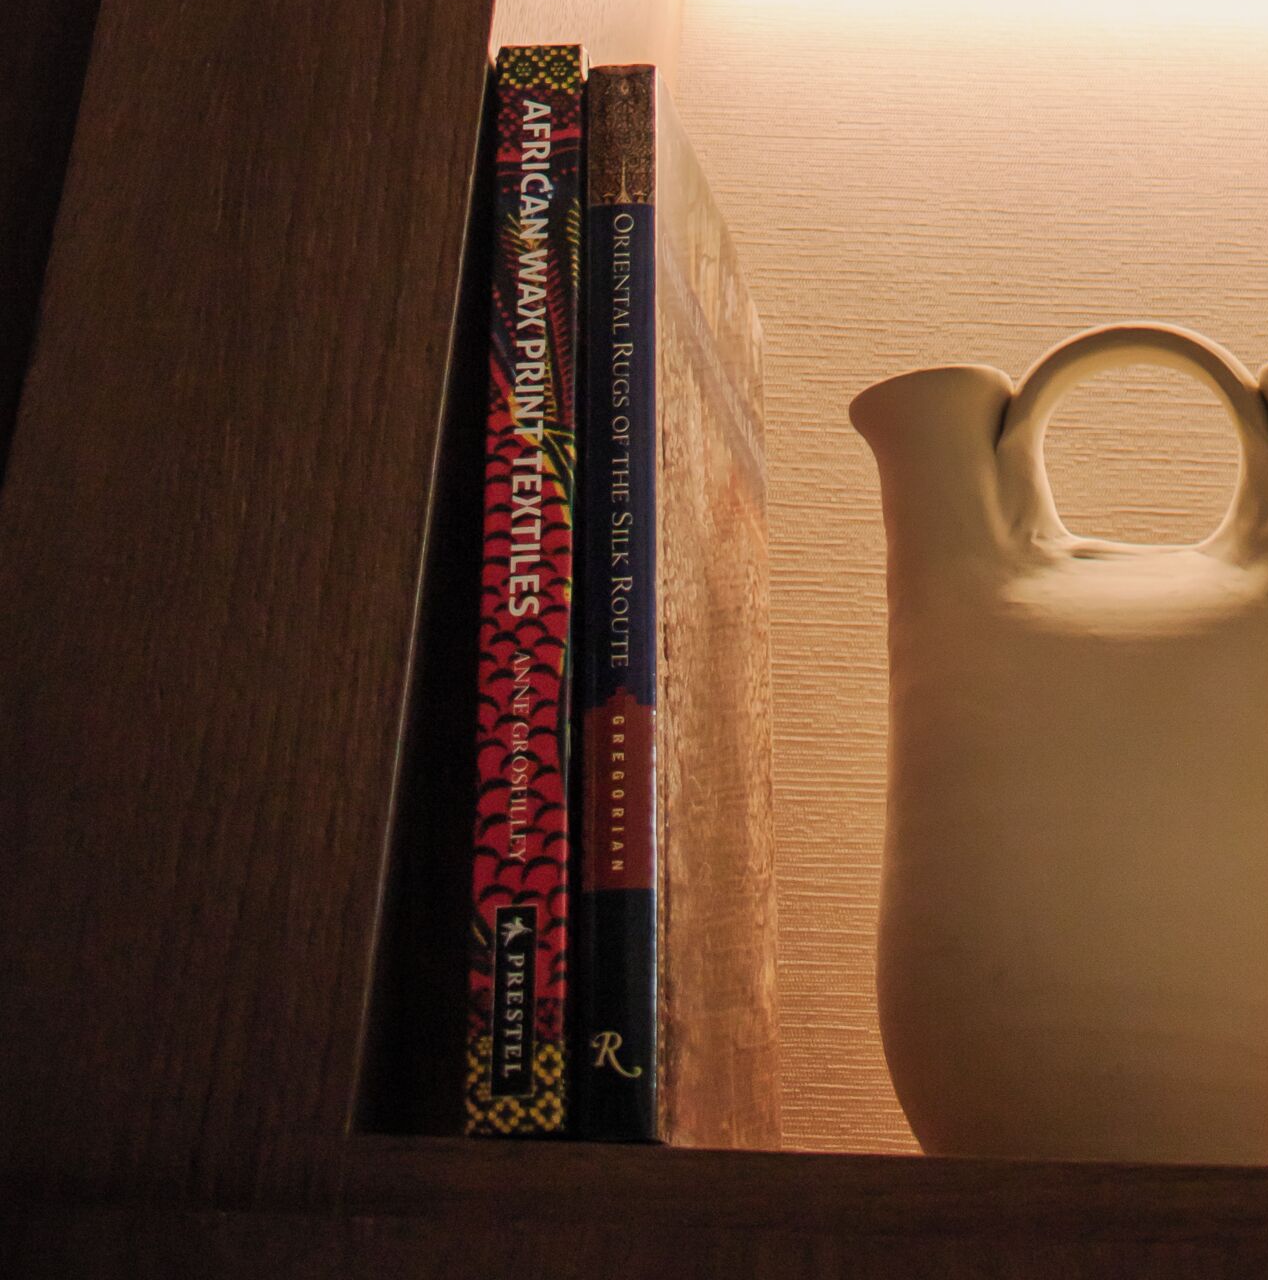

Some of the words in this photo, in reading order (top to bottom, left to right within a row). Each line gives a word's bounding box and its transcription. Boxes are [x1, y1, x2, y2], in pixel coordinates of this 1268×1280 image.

[519, 98, 551, 238] AFRICAN
[516, 247, 548, 327] WAX
[513, 337, 546, 441] PRINT
[509, 445, 544, 612] TEXTILES
[513, 649, 532, 713] ANNE
[509, 717, 530, 861] GROSFILLEY
[610, 711, 625, 871] GREGORIAN
[502, 949, 525, 1073] PRESTEL
